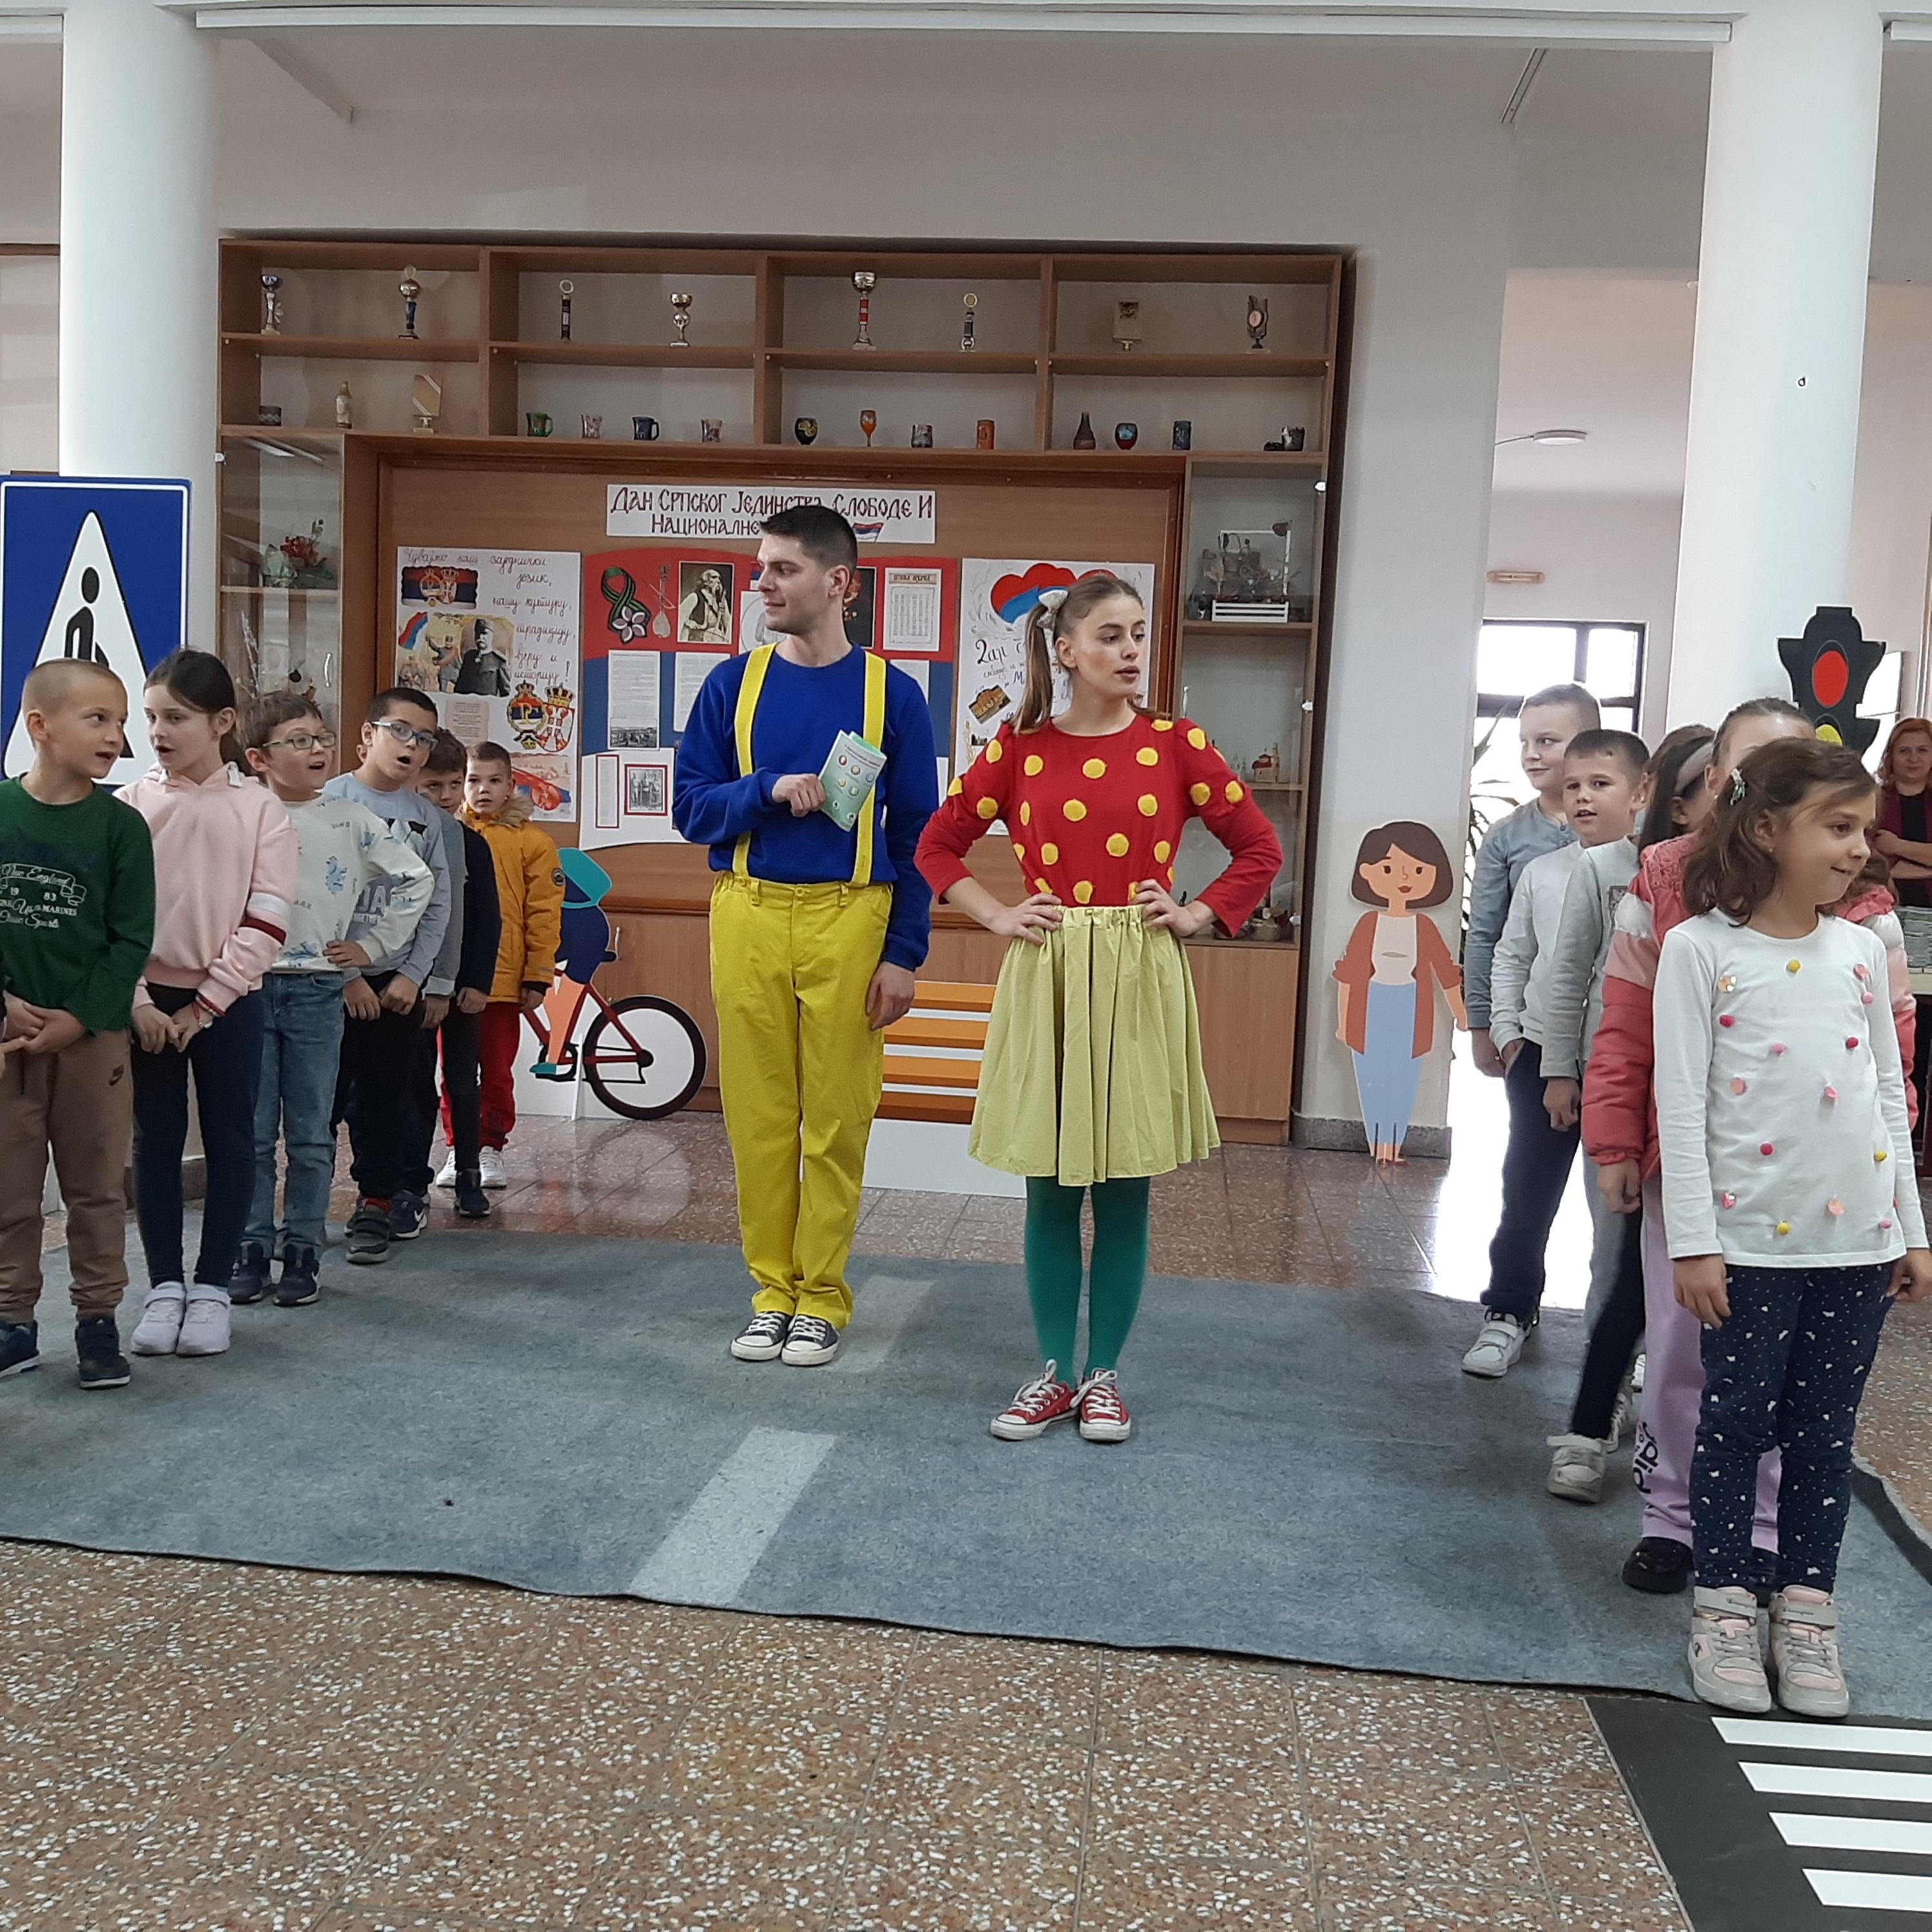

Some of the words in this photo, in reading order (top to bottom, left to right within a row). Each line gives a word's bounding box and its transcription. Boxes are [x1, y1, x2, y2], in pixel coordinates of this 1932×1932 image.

[918, 495, 933, 519] И
[10, 887, 20, 896] 19
[43, 892, 57, 901] 83
